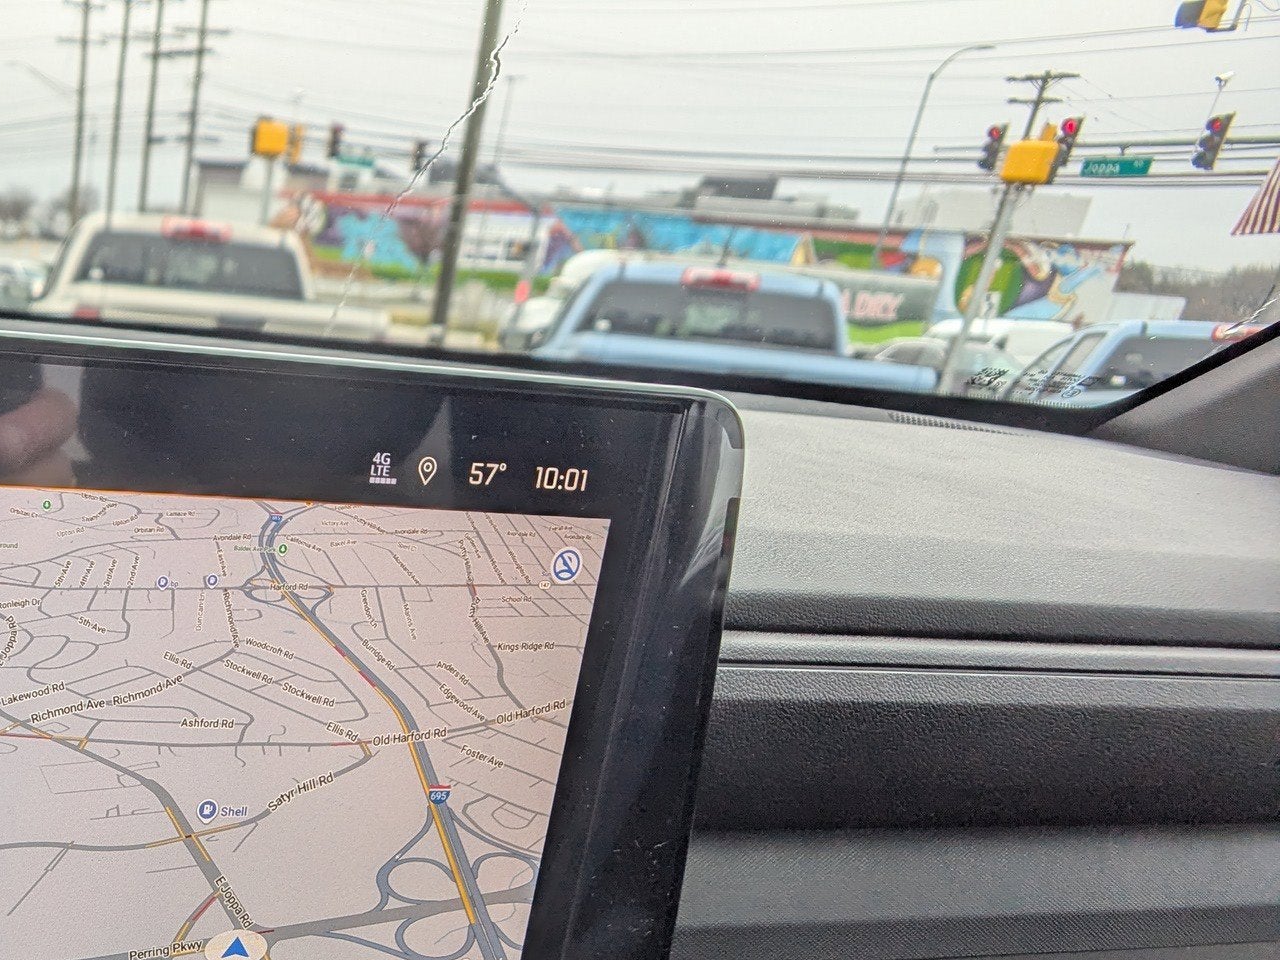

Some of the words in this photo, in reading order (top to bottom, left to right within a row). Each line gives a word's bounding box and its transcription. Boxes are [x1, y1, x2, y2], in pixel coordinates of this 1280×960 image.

[372, 452, 391, 466] 4G
[370, 464, 390, 477] LTE
[470, 462, 508, 486] 57°
[535, 466, 588, 492] 10:01
[55, 575, 64, 588] 5th
[61, 560, 72, 576] Ave
[79, 575, 90, 588] 4th
[85, 560, 96, 576] Ave
[107, 558, 118, 576] Ave
[130, 554, 140, 572] Ave
[103, 575, 113, 588] 3rd
[127, 572, 137, 587] 2nd
[170, 580, 179, 588] bp
[270, 582, 297, 590] Harford
[298, 582, 309, 590] Rd
[31, 598, 42, 606] Dr
[360, 589, 373, 618] Grendon
[5, 615, 18, 630] Rd
[77, 615, 92, 628] 5th
[90, 622, 107, 633] Ave
[223, 591, 237, 631] Richmond
[231, 629, 240, 648] Ave
[1, 628, 19, 658] Joppa
[245, 637, 280, 655] Woodcroft
[281, 648, 295, 660] Rd
[497, 642, 519, 652] Kings
[520, 642, 543, 651] Ridge
[544, 641, 556, 650] Rd
[163, 650, 181, 666] Ellis
[180, 659, 193, 671] Rd
[361, 638, 386, 664] Burridge
[384, 659, 395, 671] Rd
[223, 659, 260, 680] Stockwell
[260, 672, 274, 685] Rd
[436, 660, 460, 679] Anders
[458, 673, 470, 686] Rd
[0, 686, 51, 706] Lakewood
[51, 681, 65, 693] Rd
[112, 684, 163, 706] Richmond
[162, 674, 184, 690] Ave
[281, 682, 322, 705] Stockwell
[321, 697, 335, 708] Rd
[30, 702, 85, 724] Richmond
[86, 699, 106, 710] Ave
[439, 683, 475, 714] Edgewood
[471, 708, 486, 722] Ave
[496, 712, 514, 725] Old
[514, 702, 552, 722] Harford
[551, 698, 567, 711] Rd
[180, 718, 220, 728] Ashford
[220, 718, 235, 728] Rd
[326, 721, 347, 738] Ellis
[345, 731, 359, 743] Rd
[372, 733, 391, 746] Old
[391, 729, 433, 744] Harford
[432, 726, 448, 738] Rd
[460, 744, 489, 763] Foster
[486, 753, 505, 769] Ave
[267, 786, 297, 812] Satyr
[296, 778, 317, 795] Hill
[317, 771, 335, 786] Rd
[430, 790, 447, 801] 695
[221, 806, 248, 817] Shell
[214, 875, 227, 887] E
[220, 885, 246, 916] Joppa
[238, 911, 254, 929] Rd
[128, 945, 170, 960] Perring
[171, 940, 204, 956] Pkwy
